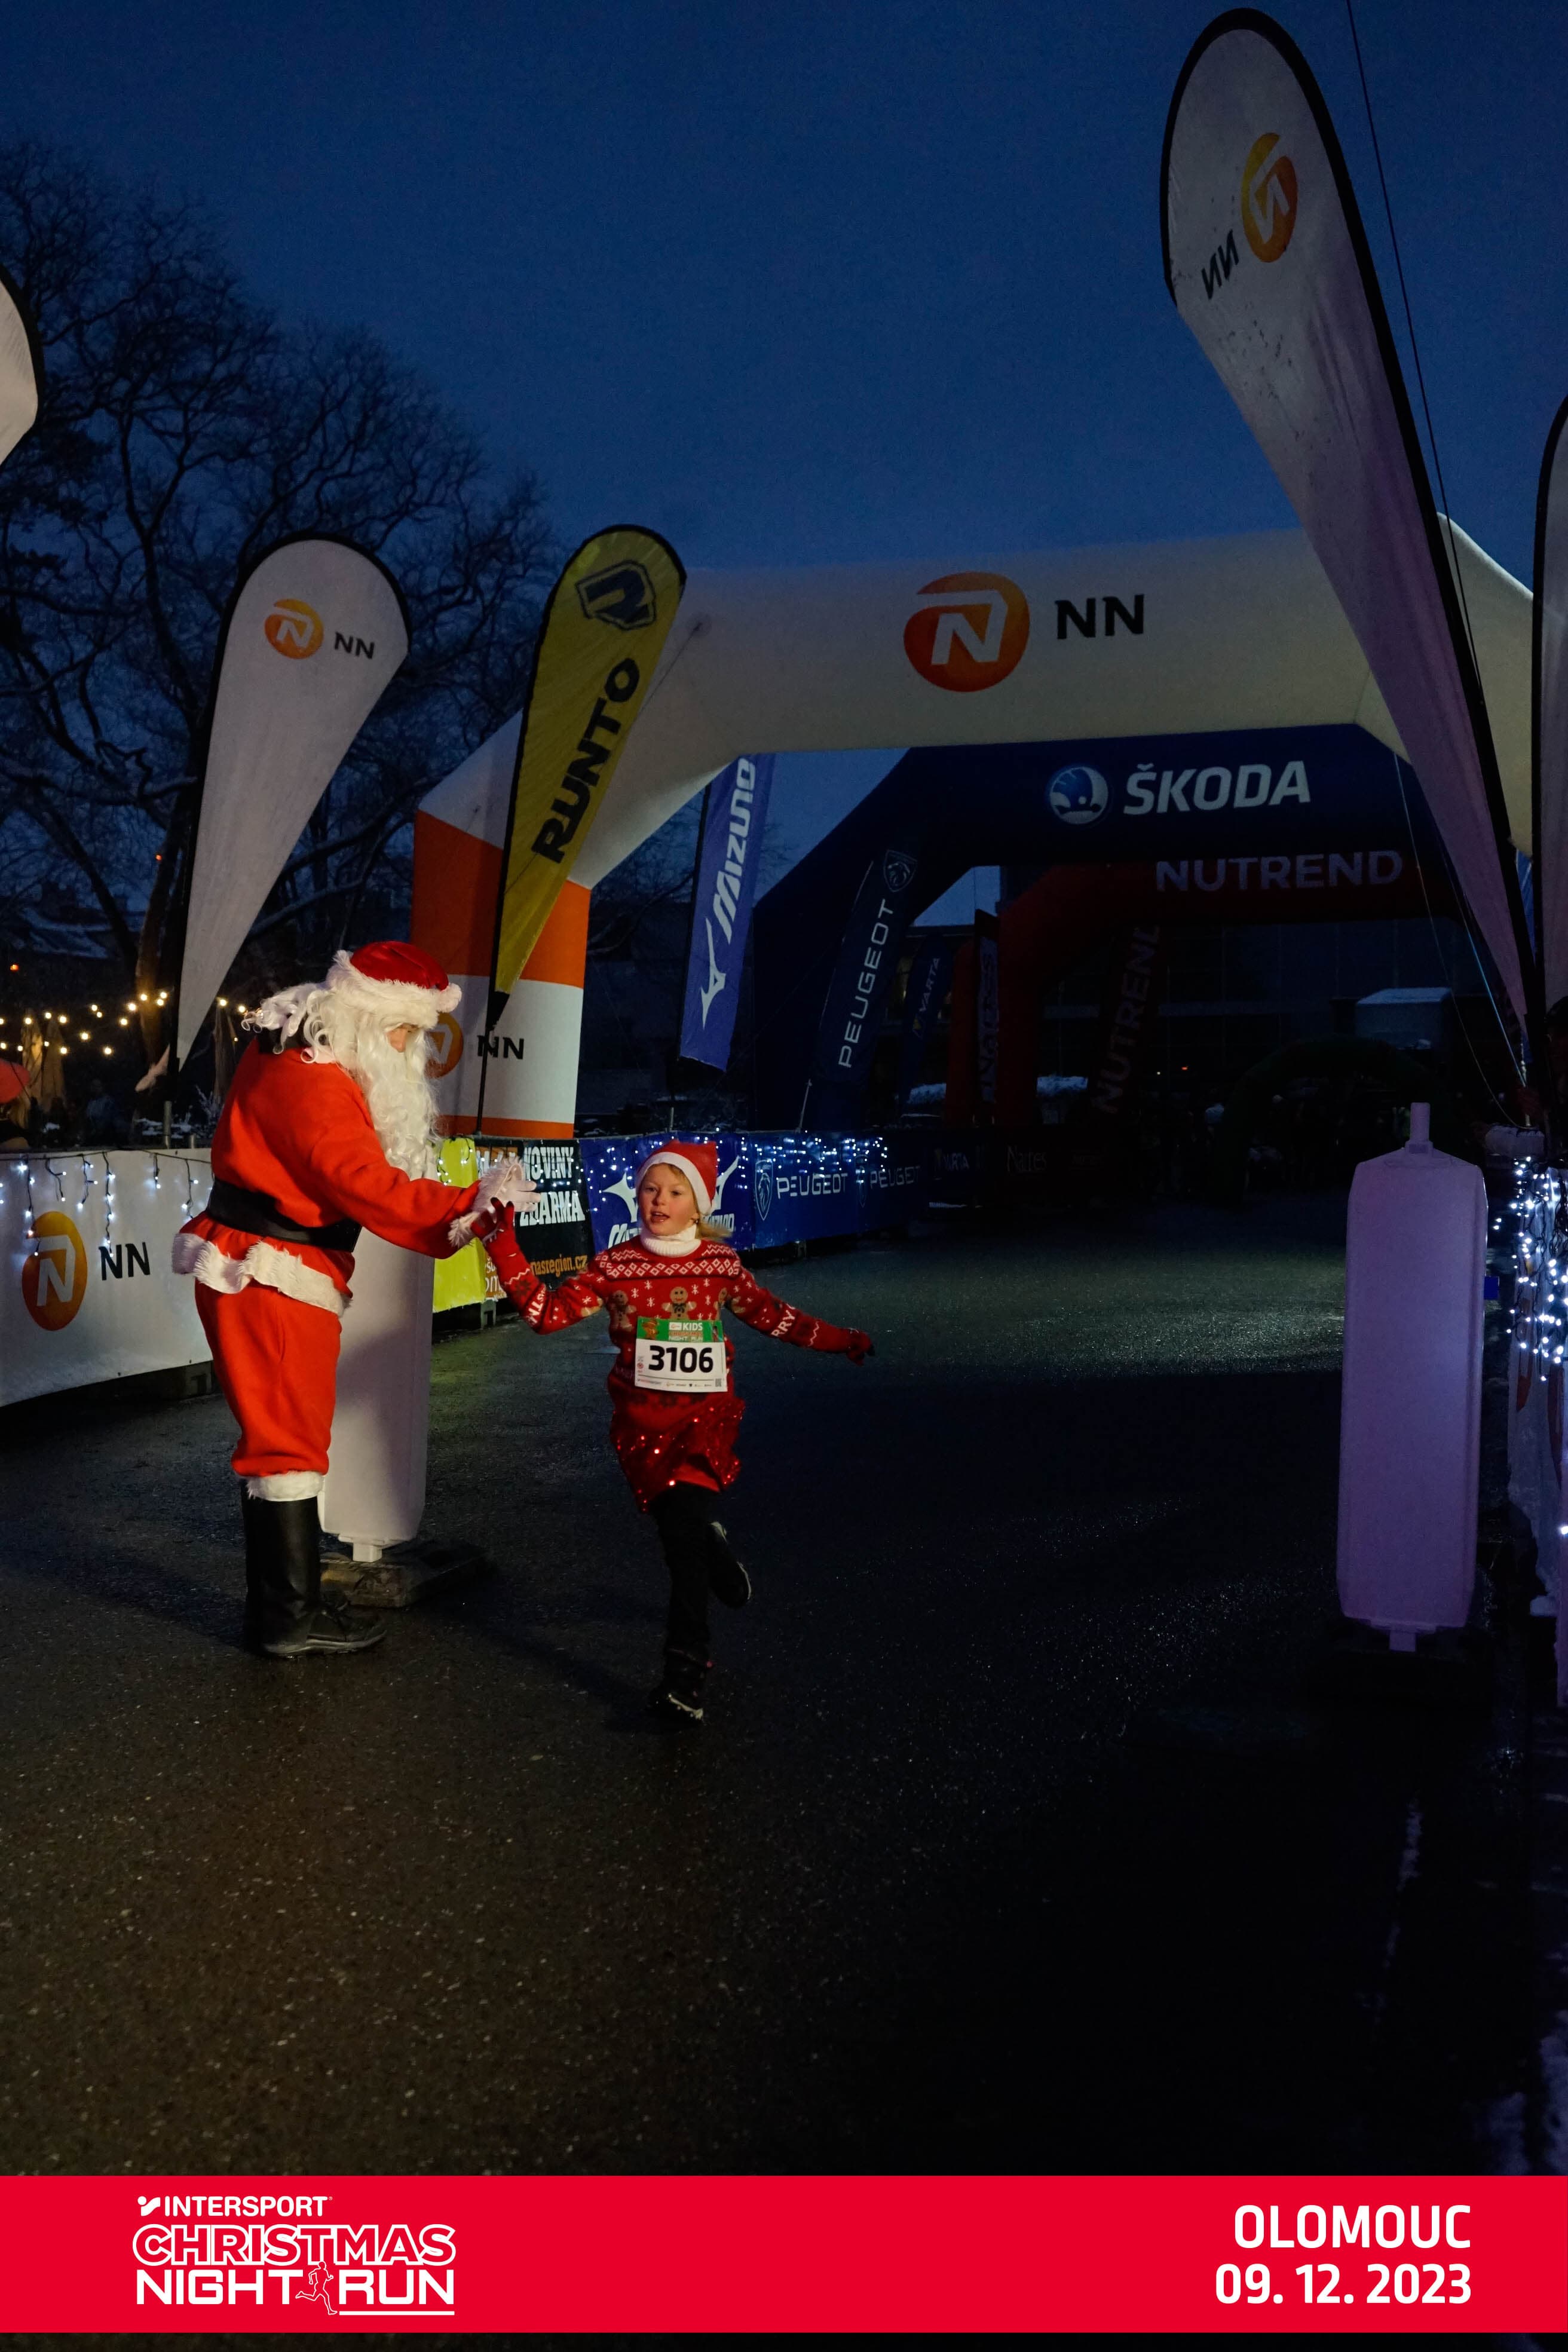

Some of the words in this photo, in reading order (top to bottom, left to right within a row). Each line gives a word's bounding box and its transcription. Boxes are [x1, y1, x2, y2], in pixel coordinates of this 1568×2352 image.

[1055, 594, 1144, 639] NN
[335, 632, 375, 659] NN
[532, 658, 639, 863] RUNTO
[1123, 760, 1312, 815] ŠKODA
[1156, 849, 1402, 892] NUTREND
[838, 899, 895, 1069] PEUGEOT
[918, 958, 941, 1012] VARTA
[477, 1035, 523, 1059] NN
[523, 1146, 574, 1180] NOVINY
[776, 1172, 848, 1199] PEUGEOT
[99, 1242, 151, 1281] NN
[682, 1322, 703, 1331] KIDS
[648, 1345, 713, 1373] 3106
